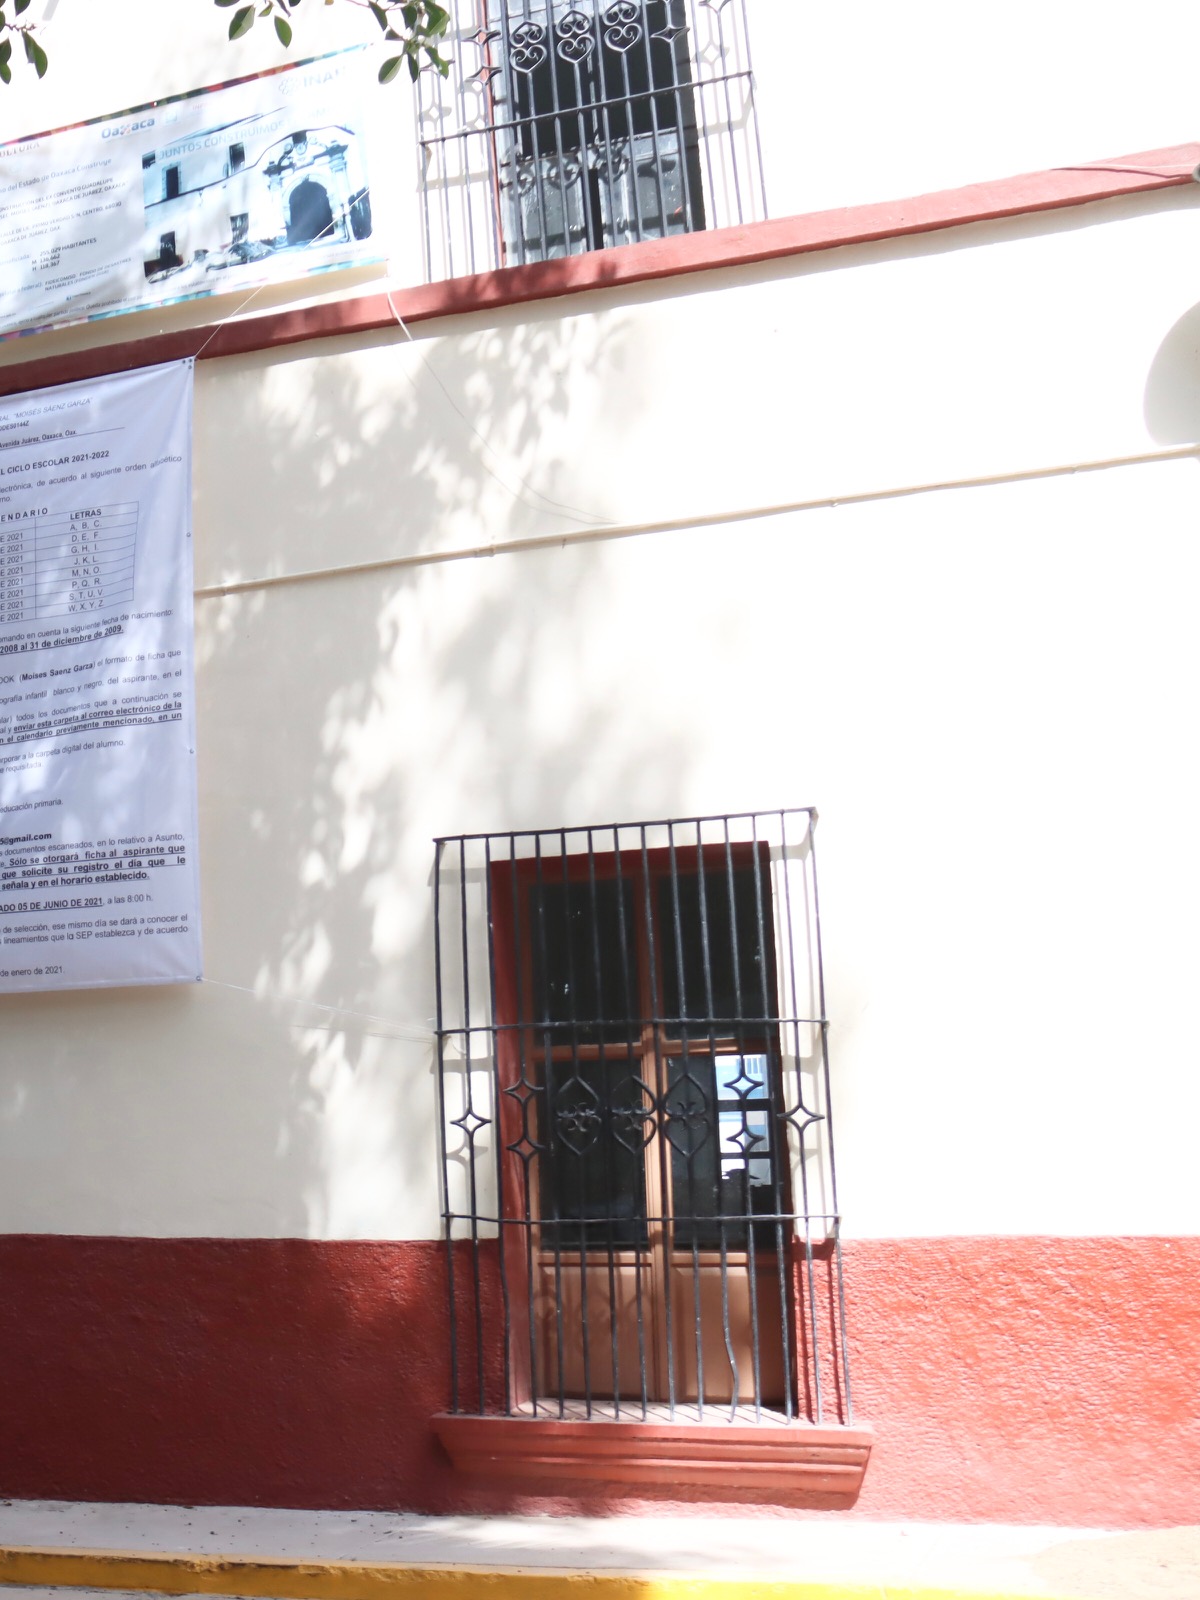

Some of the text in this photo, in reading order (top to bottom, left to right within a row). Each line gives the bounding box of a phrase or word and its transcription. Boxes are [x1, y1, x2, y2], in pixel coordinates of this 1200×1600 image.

[19, 178, 40, 188] Estado
[51, 168, 75, 178] Oaxaca
[62, 238, 97, 250] HABITANTES
[7, 464, 30, 474] CICLO
[33, 457, 70, 469] ESCOLAR
[72, 450, 110, 463] 2021-2022
[49, 474, 77, 485] acuerdo
[90, 467, 121, 480] siguiente
[125, 463, 146, 472] orden
[70, 509, 101, 520] LETRAS
[6, 532, 23, 542] 2021
[6, 544, 23, 554] 2021
[6, 556, 23, 565] 2021
[6, 601, 23, 611] 2021
[6, 612, 23, 622] 2021
[38, 629, 61, 637] cuenta
[71, 622, 100, 634] siguiente
[102, 617, 118, 627] fecha
[0, 644, 18, 654] 2008
[54, 634, 91, 646] diciembre
[105, 625, 124, 636] 2009.
[50, 668, 71, 676] Saenz
[52, 692, 168, 716] documentos continuación
[13, 702, 160, 732] enviar carpeta correo electrónico
[17, 729, 53, 742] calendario
[56, 721, 99, 736] previamente
[10, 846, 164, 867] Sólo otorgará ficha aspirante
[74, 863, 109, 873] registro
[61, 876, 92, 885] horario
[95, 872, 150, 882] establecido.
[43, 900, 68, 909] JUNIO
[84, 898, 102, 906] 2021
[127, 894, 143, 903] 8:00
[147, 914, 178, 923] conocer
[95, 929, 135, 938] establezca
[156, 926, 188, 934] acuerdo
[11, 968, 32, 976] enero
